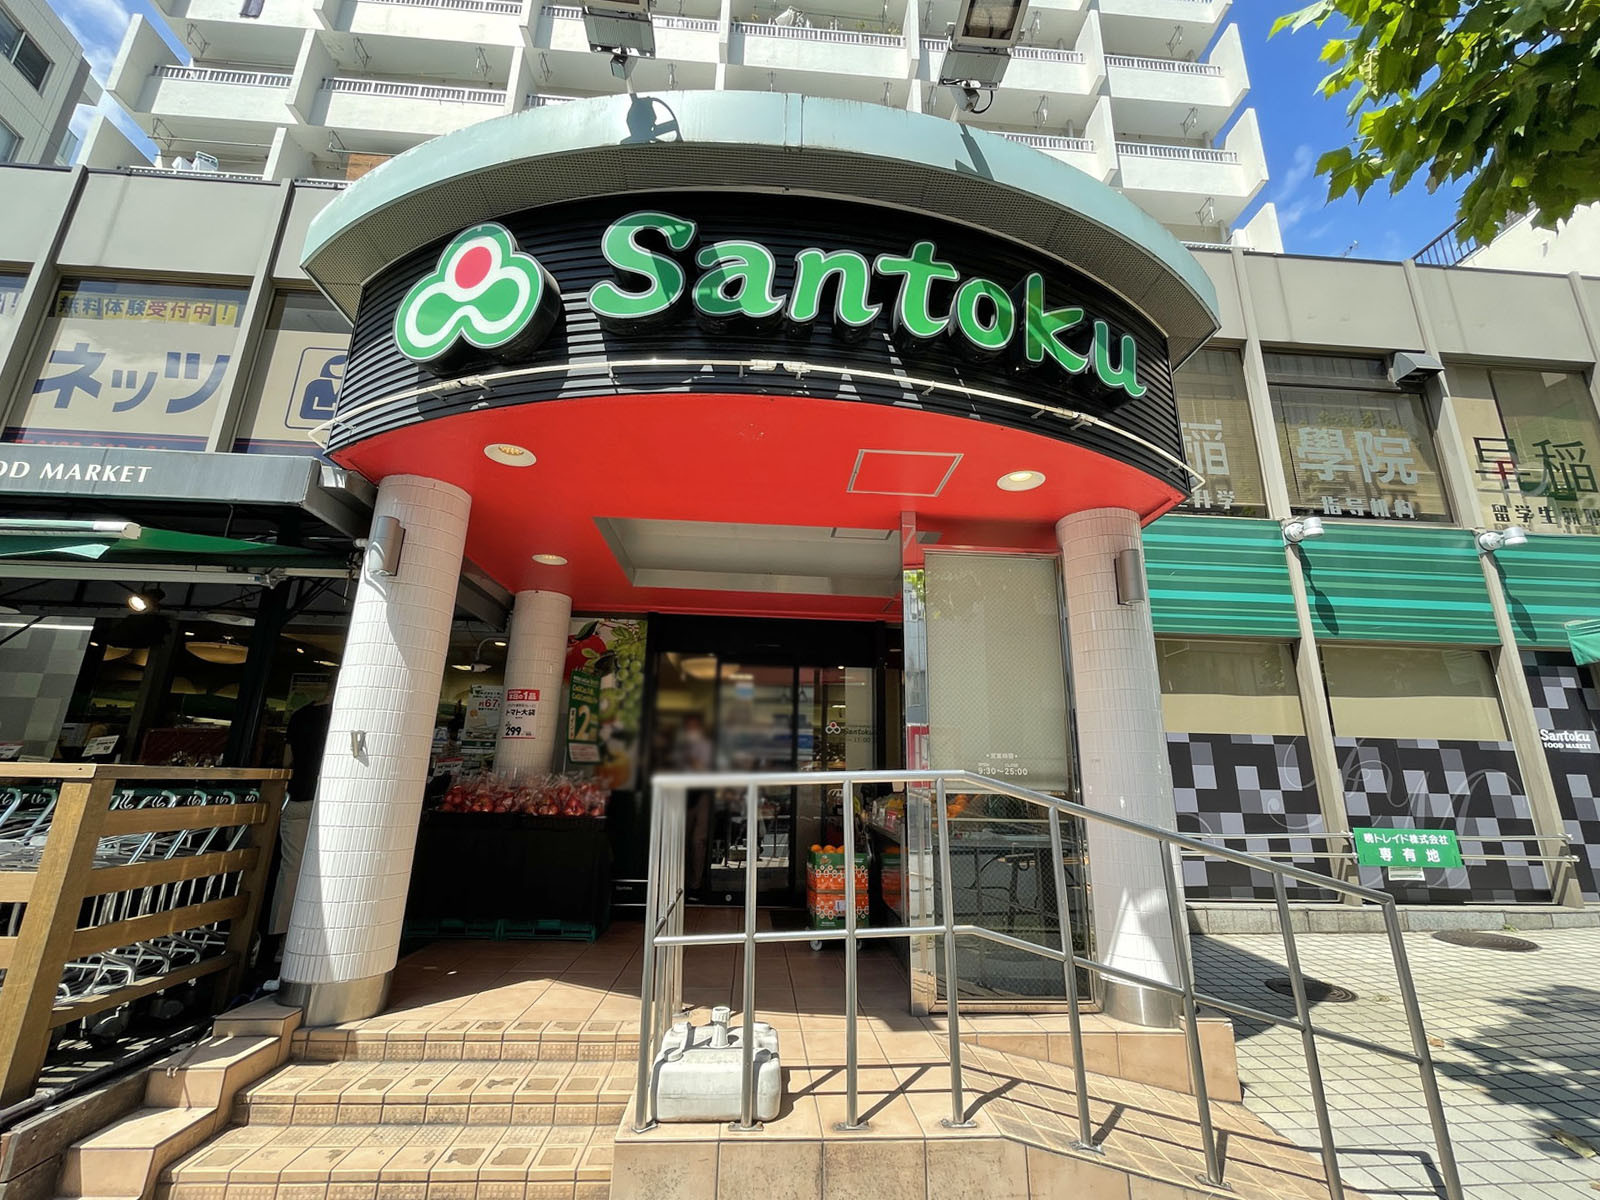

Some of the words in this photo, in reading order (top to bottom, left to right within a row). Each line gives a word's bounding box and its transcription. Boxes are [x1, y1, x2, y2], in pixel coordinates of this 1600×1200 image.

[588, 209, 1147, 398] Santoku
[32, 342, 231, 414] ネッツ
[39, 462, 152, 483] MARKET
[505, 726, 521, 736] 299
[1540, 729, 1591, 742] Santoku
